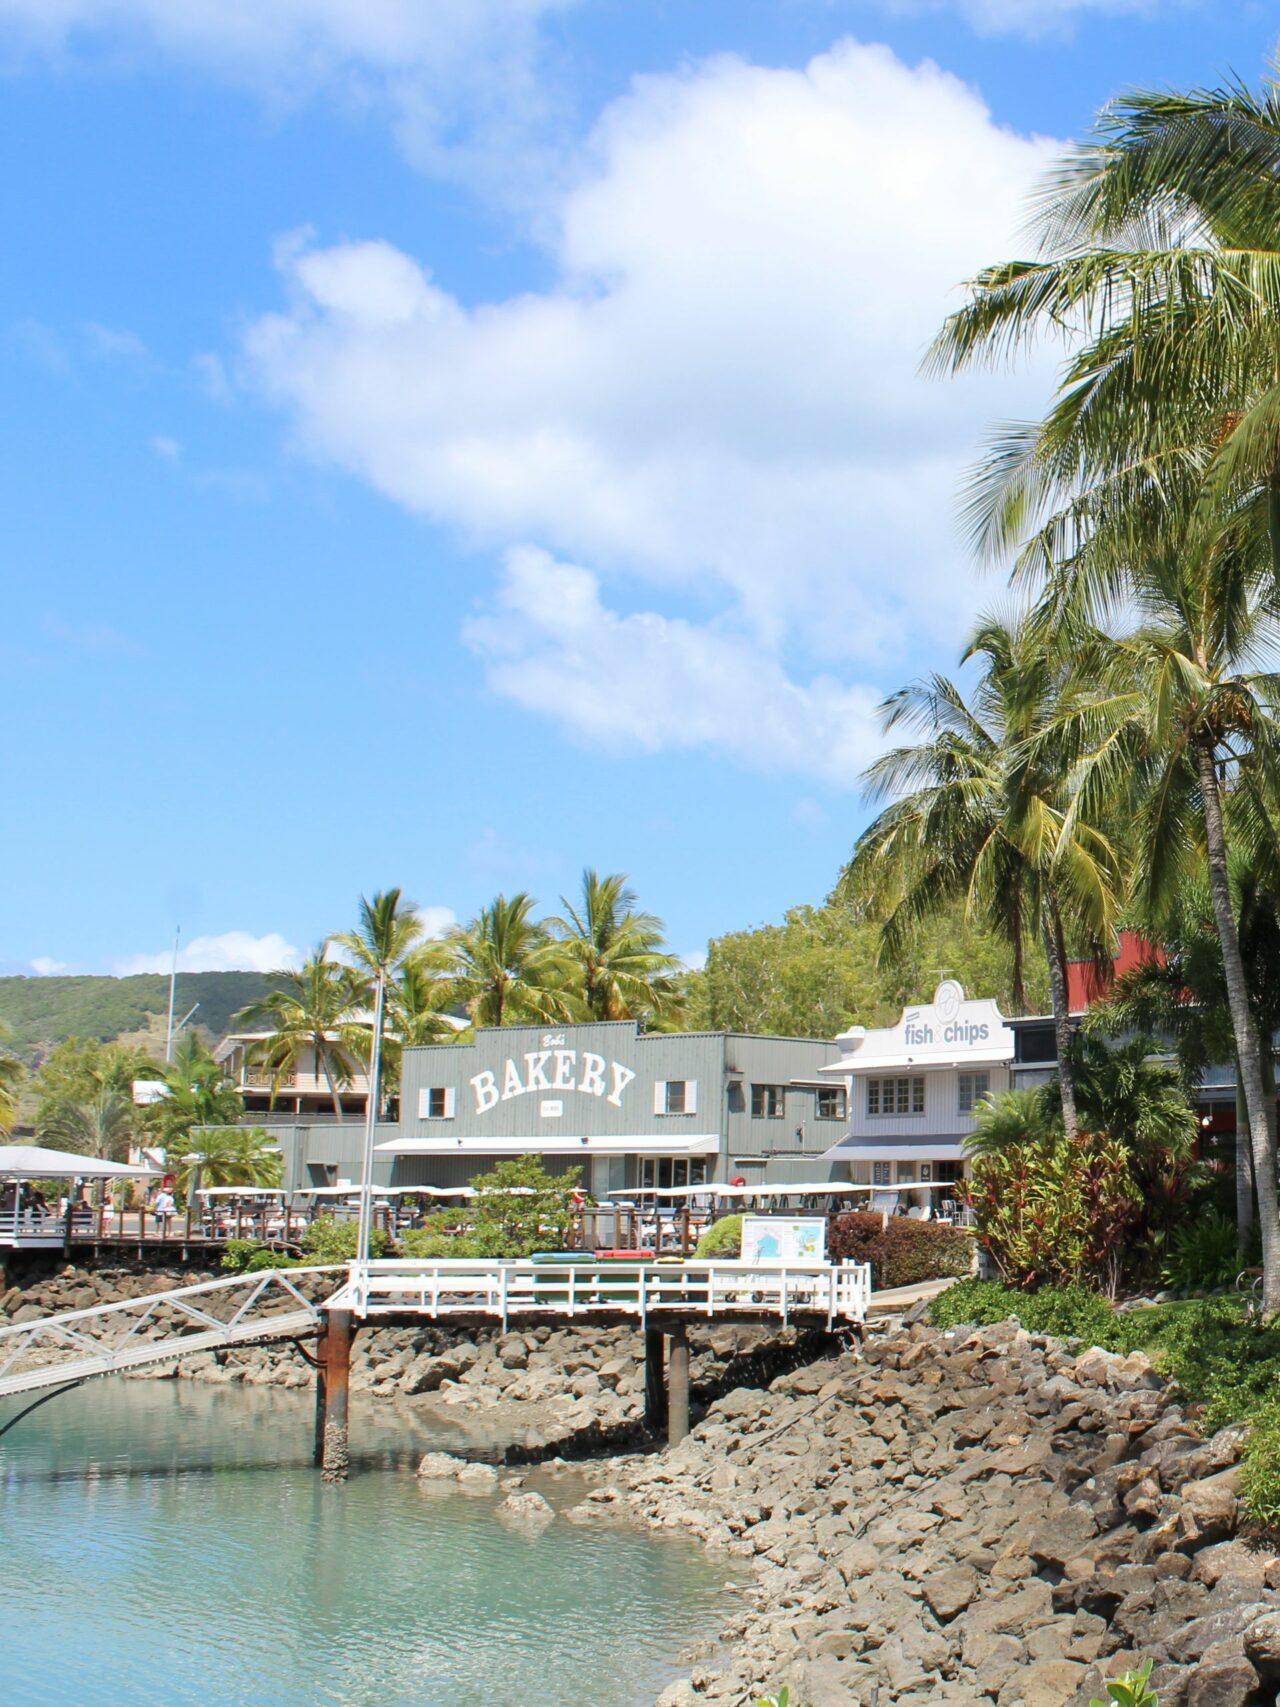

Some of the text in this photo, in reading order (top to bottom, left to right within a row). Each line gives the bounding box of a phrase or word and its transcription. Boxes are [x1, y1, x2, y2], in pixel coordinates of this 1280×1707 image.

[543, 1034, 565, 1047] Bob's
[905, 1023, 933, 1045] fish
[943, 1020, 989, 1045] chips
[469, 1049, 637, 1115] BAKERY
